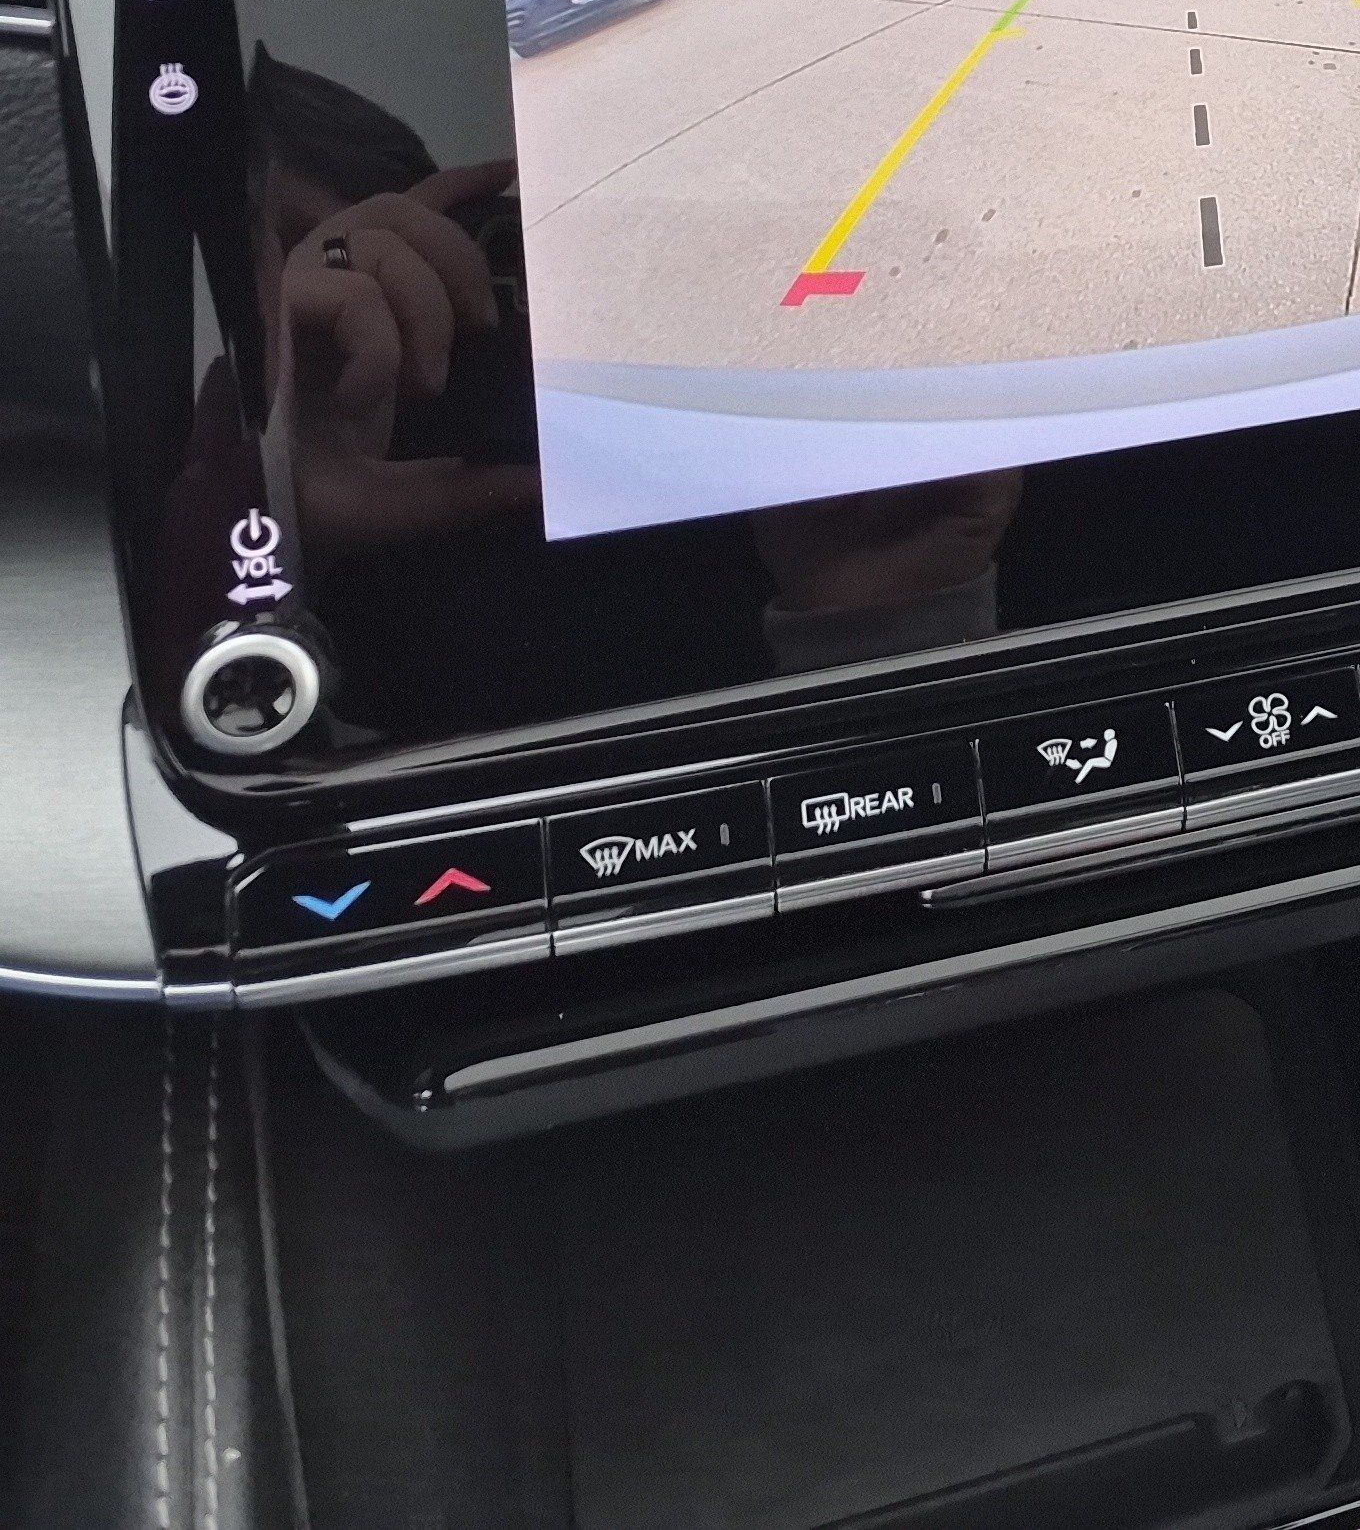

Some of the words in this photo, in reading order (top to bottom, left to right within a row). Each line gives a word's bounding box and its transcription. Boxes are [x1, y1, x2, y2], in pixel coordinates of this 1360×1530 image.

[231, 555, 284, 580] VOL
[1259, 728, 1291, 750] OFF
[850, 787, 914, 819] REAR
[635, 828, 698, 861] MAX
